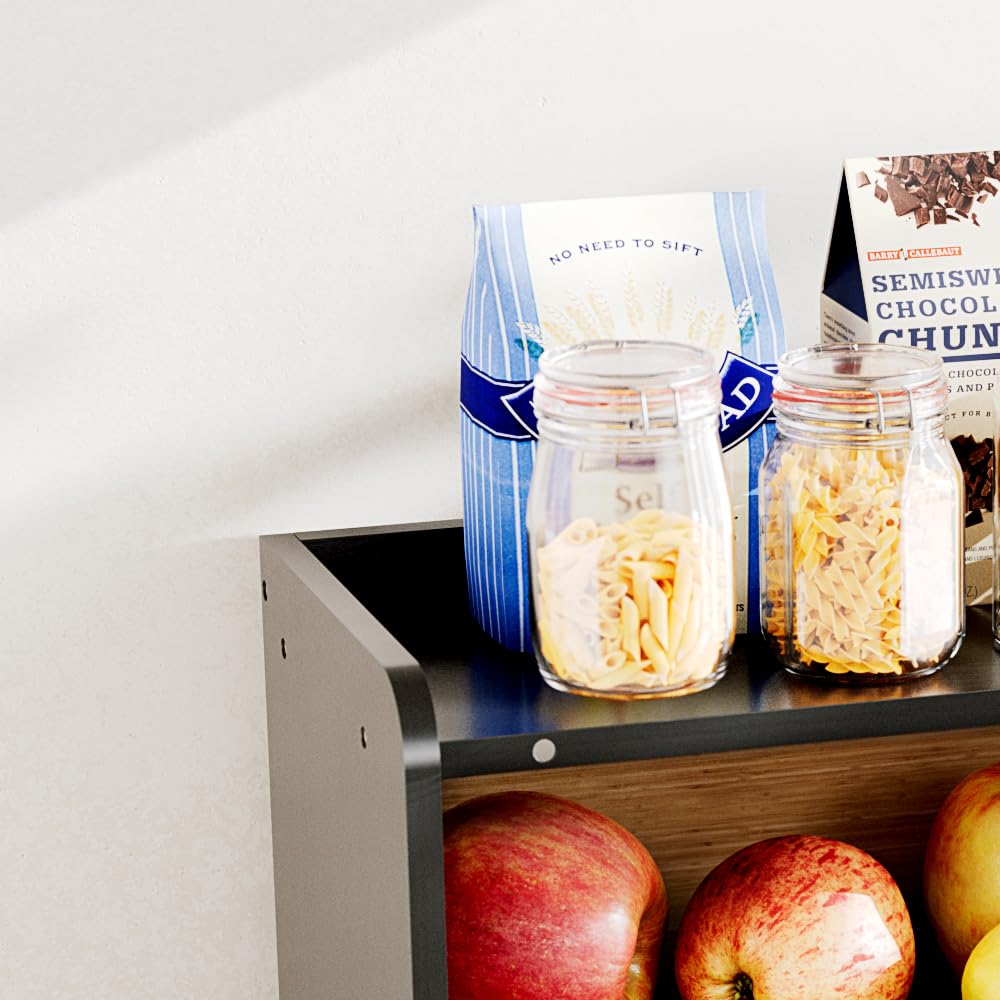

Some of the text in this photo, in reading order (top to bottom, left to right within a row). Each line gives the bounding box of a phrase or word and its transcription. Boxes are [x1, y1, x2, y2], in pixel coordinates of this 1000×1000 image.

[549, 239, 703, 265] NO NEED TO SIFT
[869, 247, 961, 261] BARRY CALLEBAUT
[957, 383, 983, 393] AND
